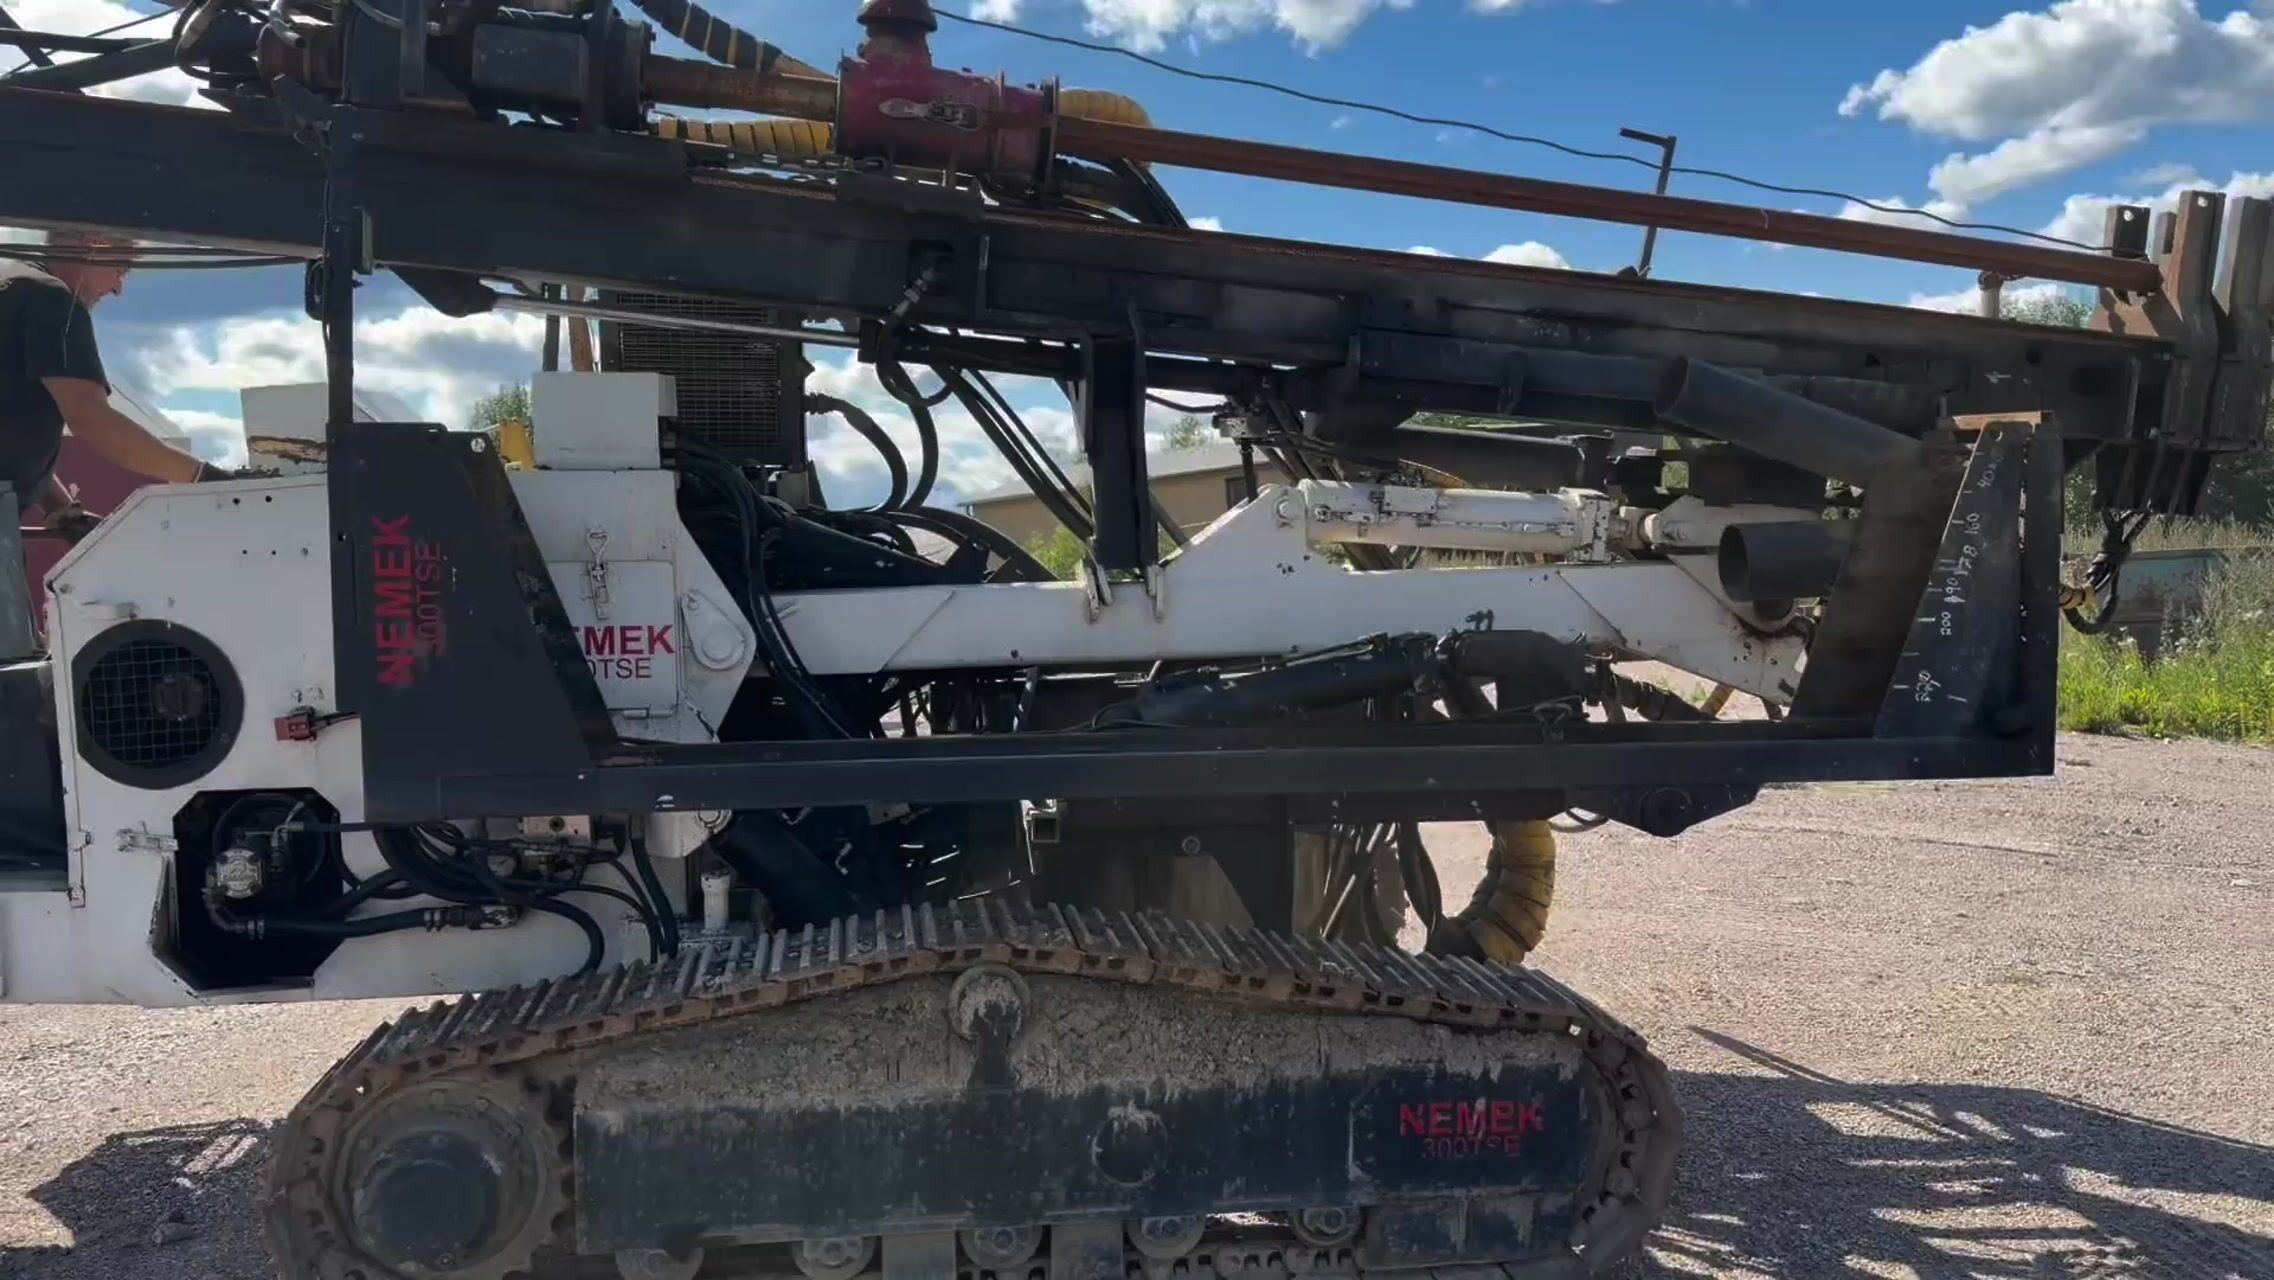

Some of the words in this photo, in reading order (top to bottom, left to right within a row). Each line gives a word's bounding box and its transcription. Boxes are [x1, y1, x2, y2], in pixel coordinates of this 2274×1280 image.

[372, 513, 415, 685] NEMEK
[571, 624, 675, 656] MEK
[1940, 611, 1952, 635] 200
[1400, 1100, 1545, 1137] NEMEK
